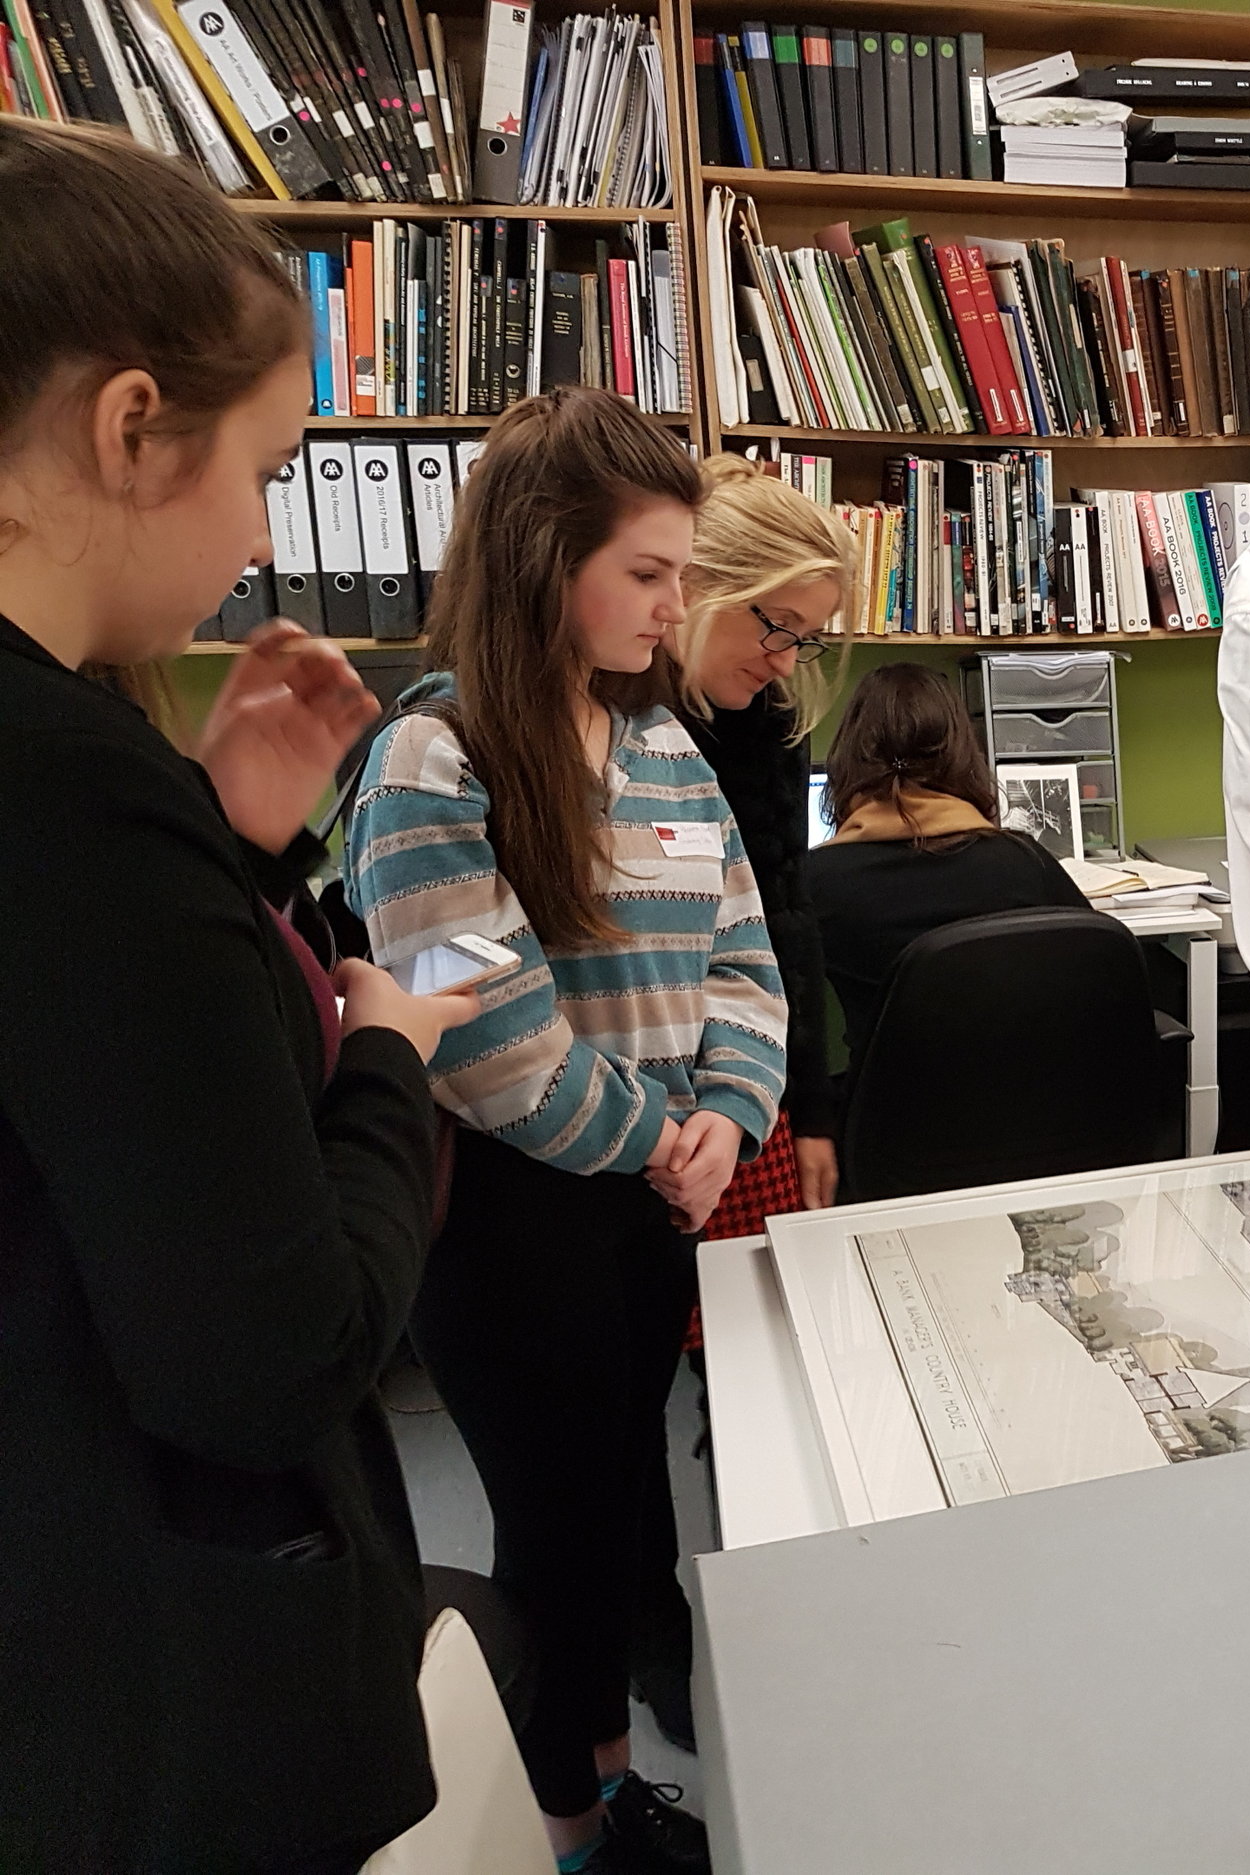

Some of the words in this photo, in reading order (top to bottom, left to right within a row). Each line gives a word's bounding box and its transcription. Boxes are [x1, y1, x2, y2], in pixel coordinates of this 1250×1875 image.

[281, 487, 293, 510] Digital
[376, 486, 387, 516] 2016/17
[424, 484, 433, 510] Articles
[434, 484, 445, 528] Architectural
[1141, 500, 1152, 518] AA
[1188, 494, 1195, 504] AA
[1205, 496, 1212, 507] AA
[1241, 493, 1246, 506] 2
[331, 501, 341, 532] Receipts
[1101, 509, 1106, 518] AA
[1190, 505, 1198, 525] BOOK
[1207, 508, 1215, 528] BOOK
[285, 512, 298, 558] Preservation
[380, 517, 390, 550] Receipts
[1145, 521, 1165, 556] BOOK
[1242, 530, 1248, 543] 1
[1059, 543, 1071, 551] AA
[1163, 517, 1170, 533] AA
[1167, 535, 1180, 568] BOOK
[1175, 570, 1186, 595] 2016
[1196, 530, 1206, 566] PROJECTS
[1211, 531, 1222, 567] PROJECTS
[1157, 559, 1170, 587] 2015
[1203, 567, 1213, 593] REVIEW
[896, 1279, 915, 1306] BANK
[925, 1355, 953, 1396] COUNTRY
[942, 1398, 967, 1431] HOUSE
